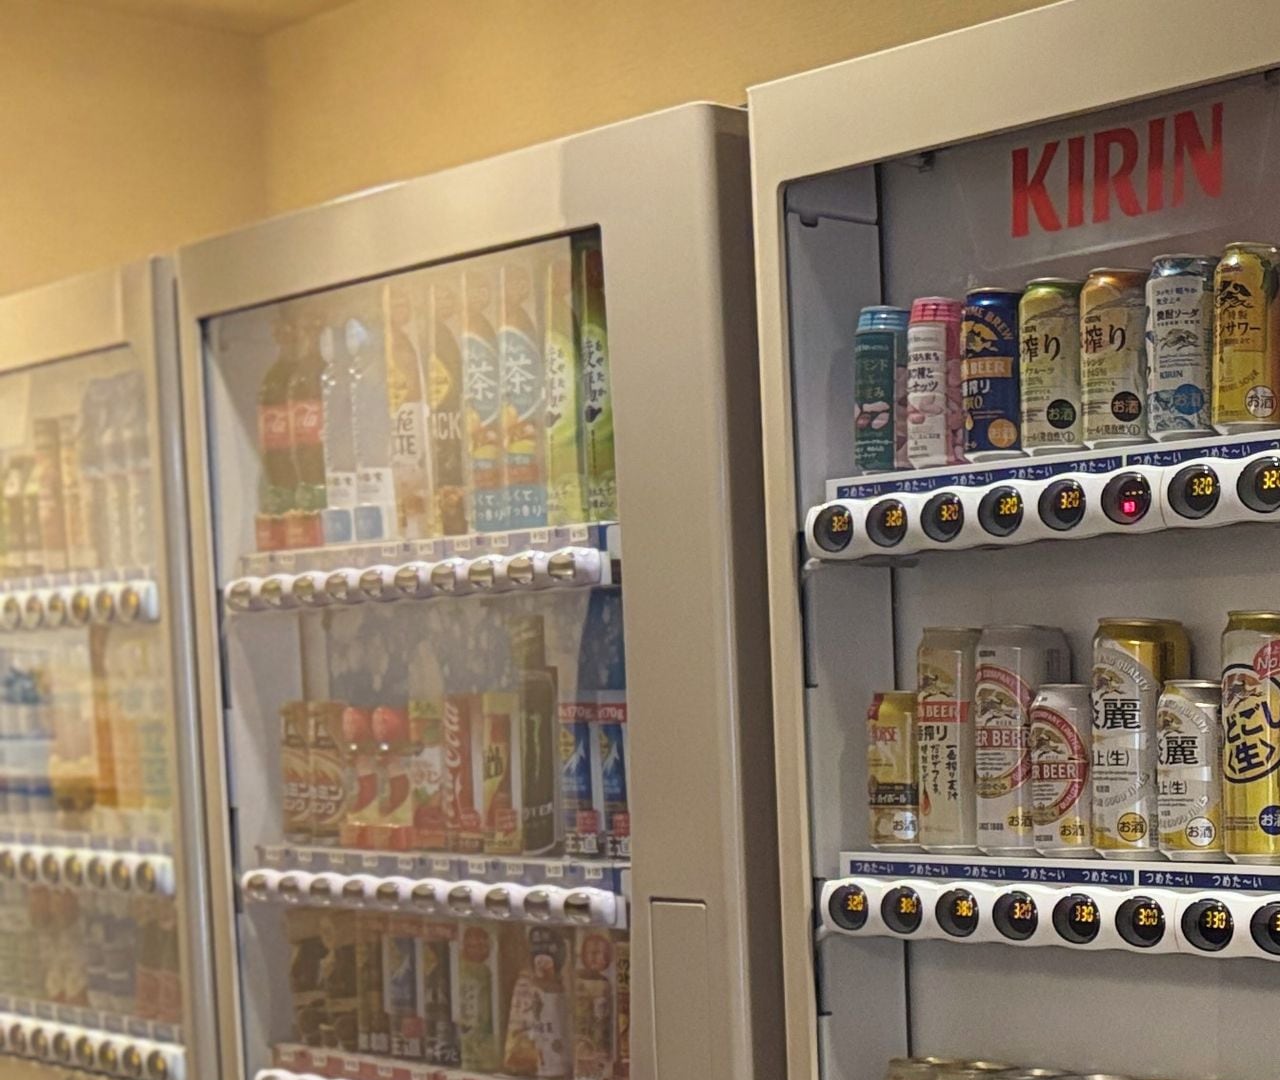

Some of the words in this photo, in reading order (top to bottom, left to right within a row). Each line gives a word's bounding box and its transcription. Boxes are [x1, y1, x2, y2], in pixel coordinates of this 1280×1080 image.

[1010, 101, 1226, 238] KIRIN
[1112, 397, 1139, 414] お酒
[1061, 492, 1081, 510] 320
[1119, 819, 1145, 834] お酒
[1205, 910, 1226, 929] 330
